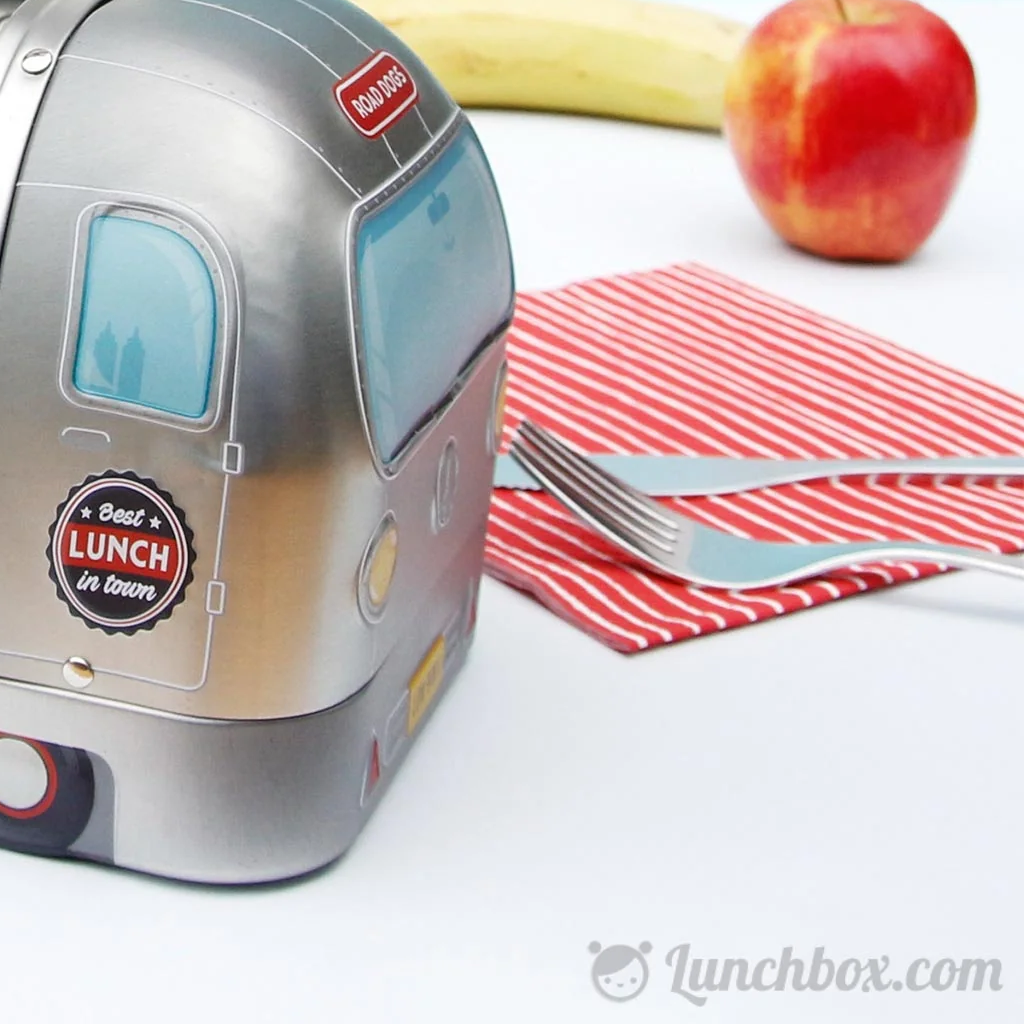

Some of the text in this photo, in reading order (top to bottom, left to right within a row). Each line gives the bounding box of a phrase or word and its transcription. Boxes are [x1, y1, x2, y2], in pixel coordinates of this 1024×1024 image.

[351, 65, 407, 119] ROAD DOGS
[98, 502, 145, 527] Best
[68, 530, 170, 572] LUNCH
[76, 570, 157, 602] in town
